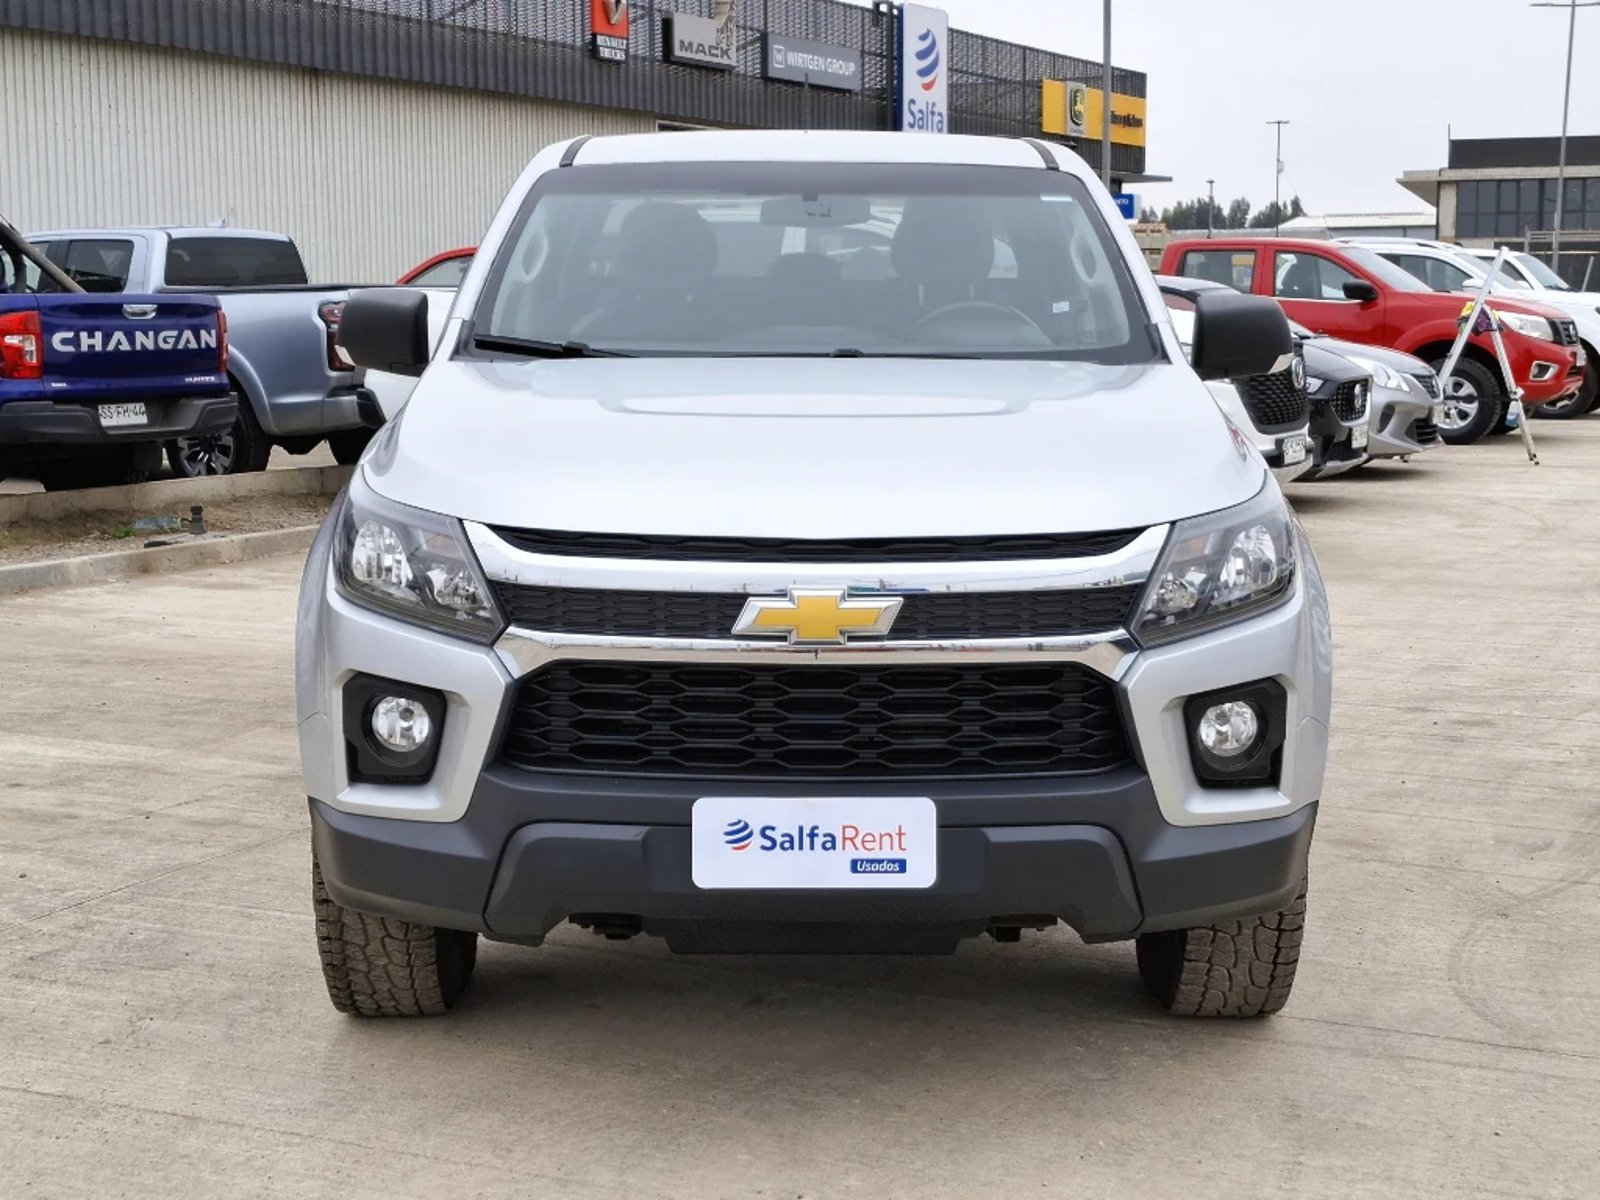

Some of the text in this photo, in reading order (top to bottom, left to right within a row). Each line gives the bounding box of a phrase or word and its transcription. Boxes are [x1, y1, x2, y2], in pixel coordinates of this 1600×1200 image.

[679, 40, 733, 60] MACK
[786, 51, 856, 76] WIRTGEN GROUP
[907, 98, 944, 132] Salfa
[51, 329, 217, 352] CHANGAN
[857, 860, 901, 872] Usados
